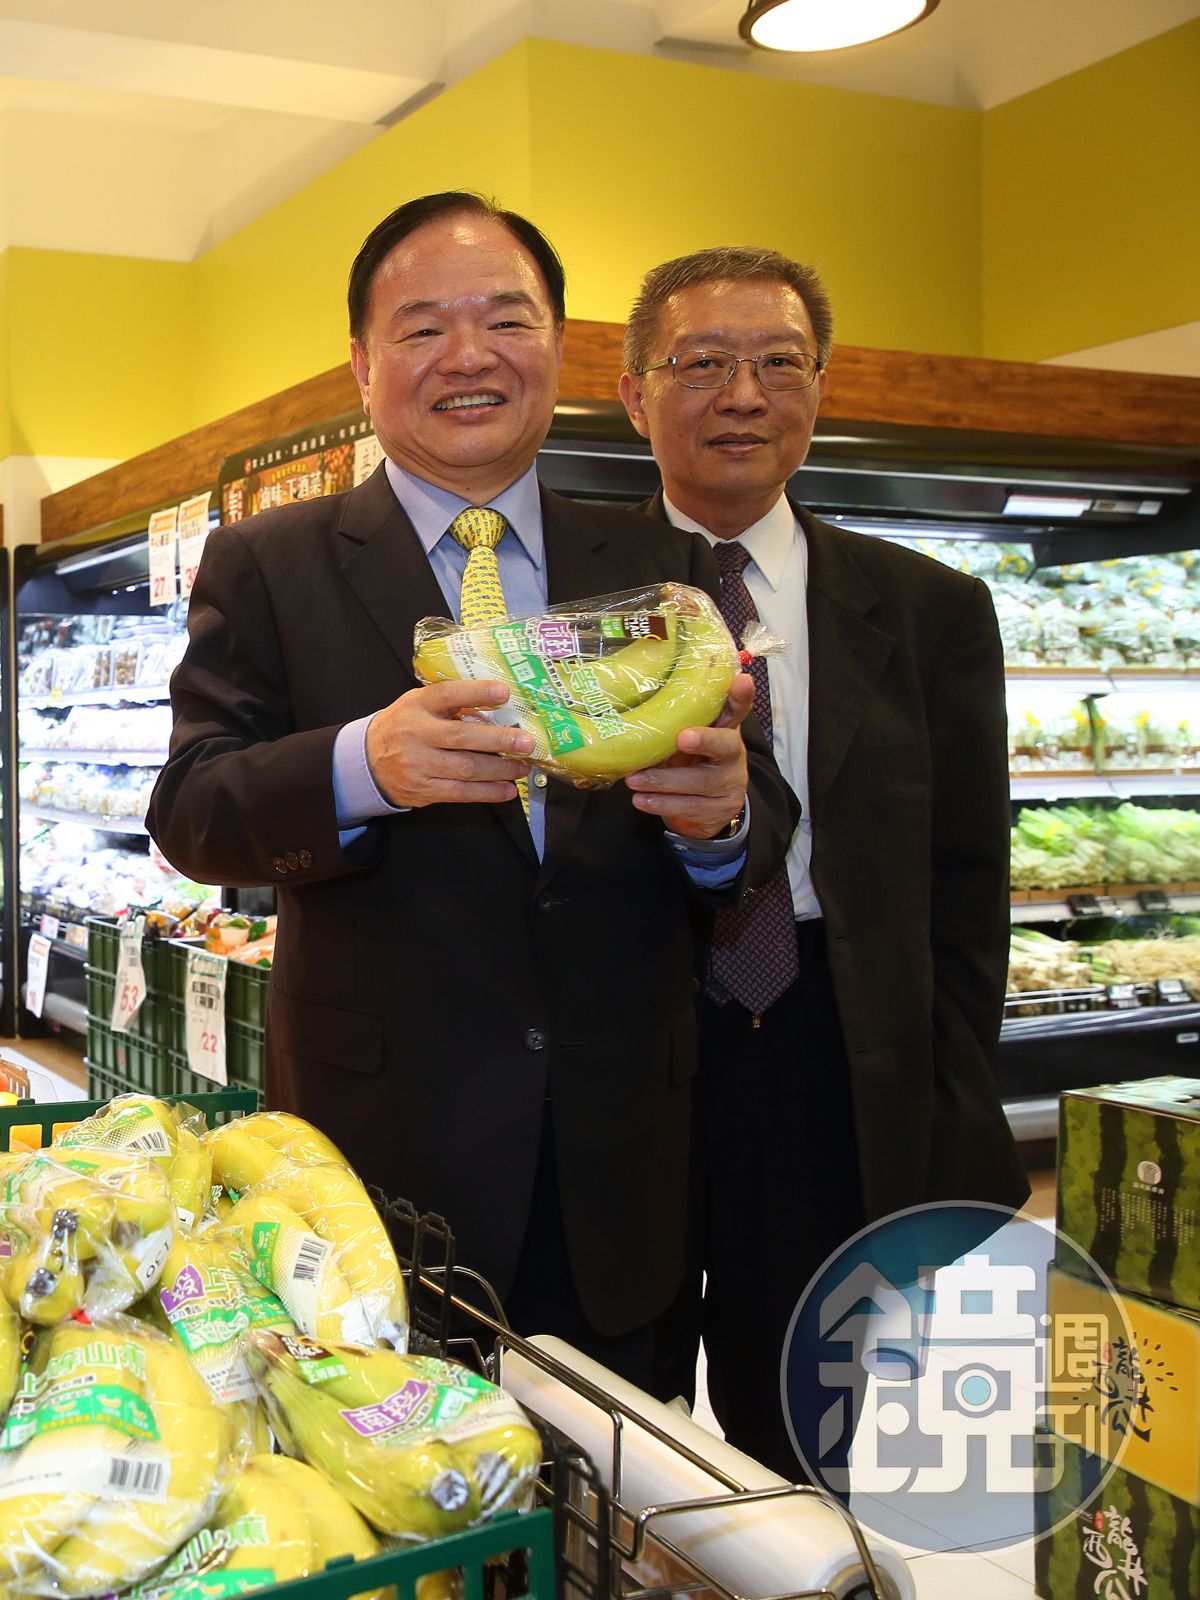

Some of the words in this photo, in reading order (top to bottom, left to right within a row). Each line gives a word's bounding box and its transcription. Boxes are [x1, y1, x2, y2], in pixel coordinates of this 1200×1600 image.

[638, 617, 650, 635] SUN
[201, 1031, 218, 1054] 22
[350, 1383, 422, 1432] 南投
